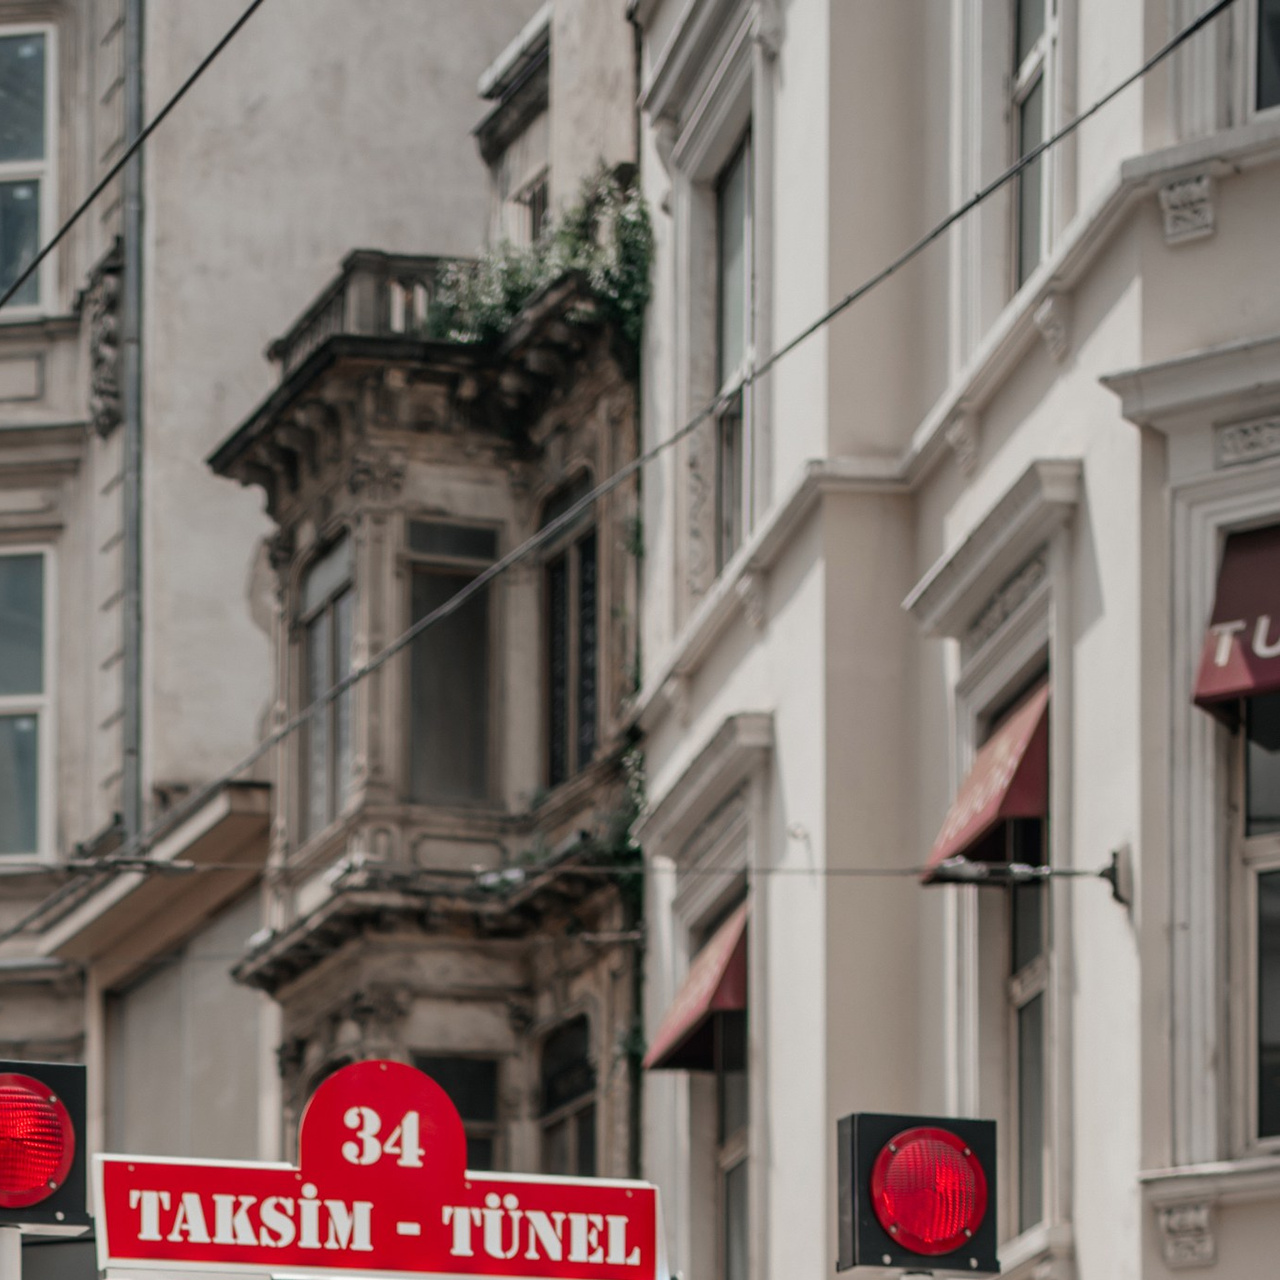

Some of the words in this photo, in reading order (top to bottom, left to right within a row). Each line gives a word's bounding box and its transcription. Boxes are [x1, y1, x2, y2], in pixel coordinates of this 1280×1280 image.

[342, 1106, 426, 1168] 34
[129, 1183, 374, 1252] TAKSİM
[442, 1193, 641, 1266] TÜNEL
